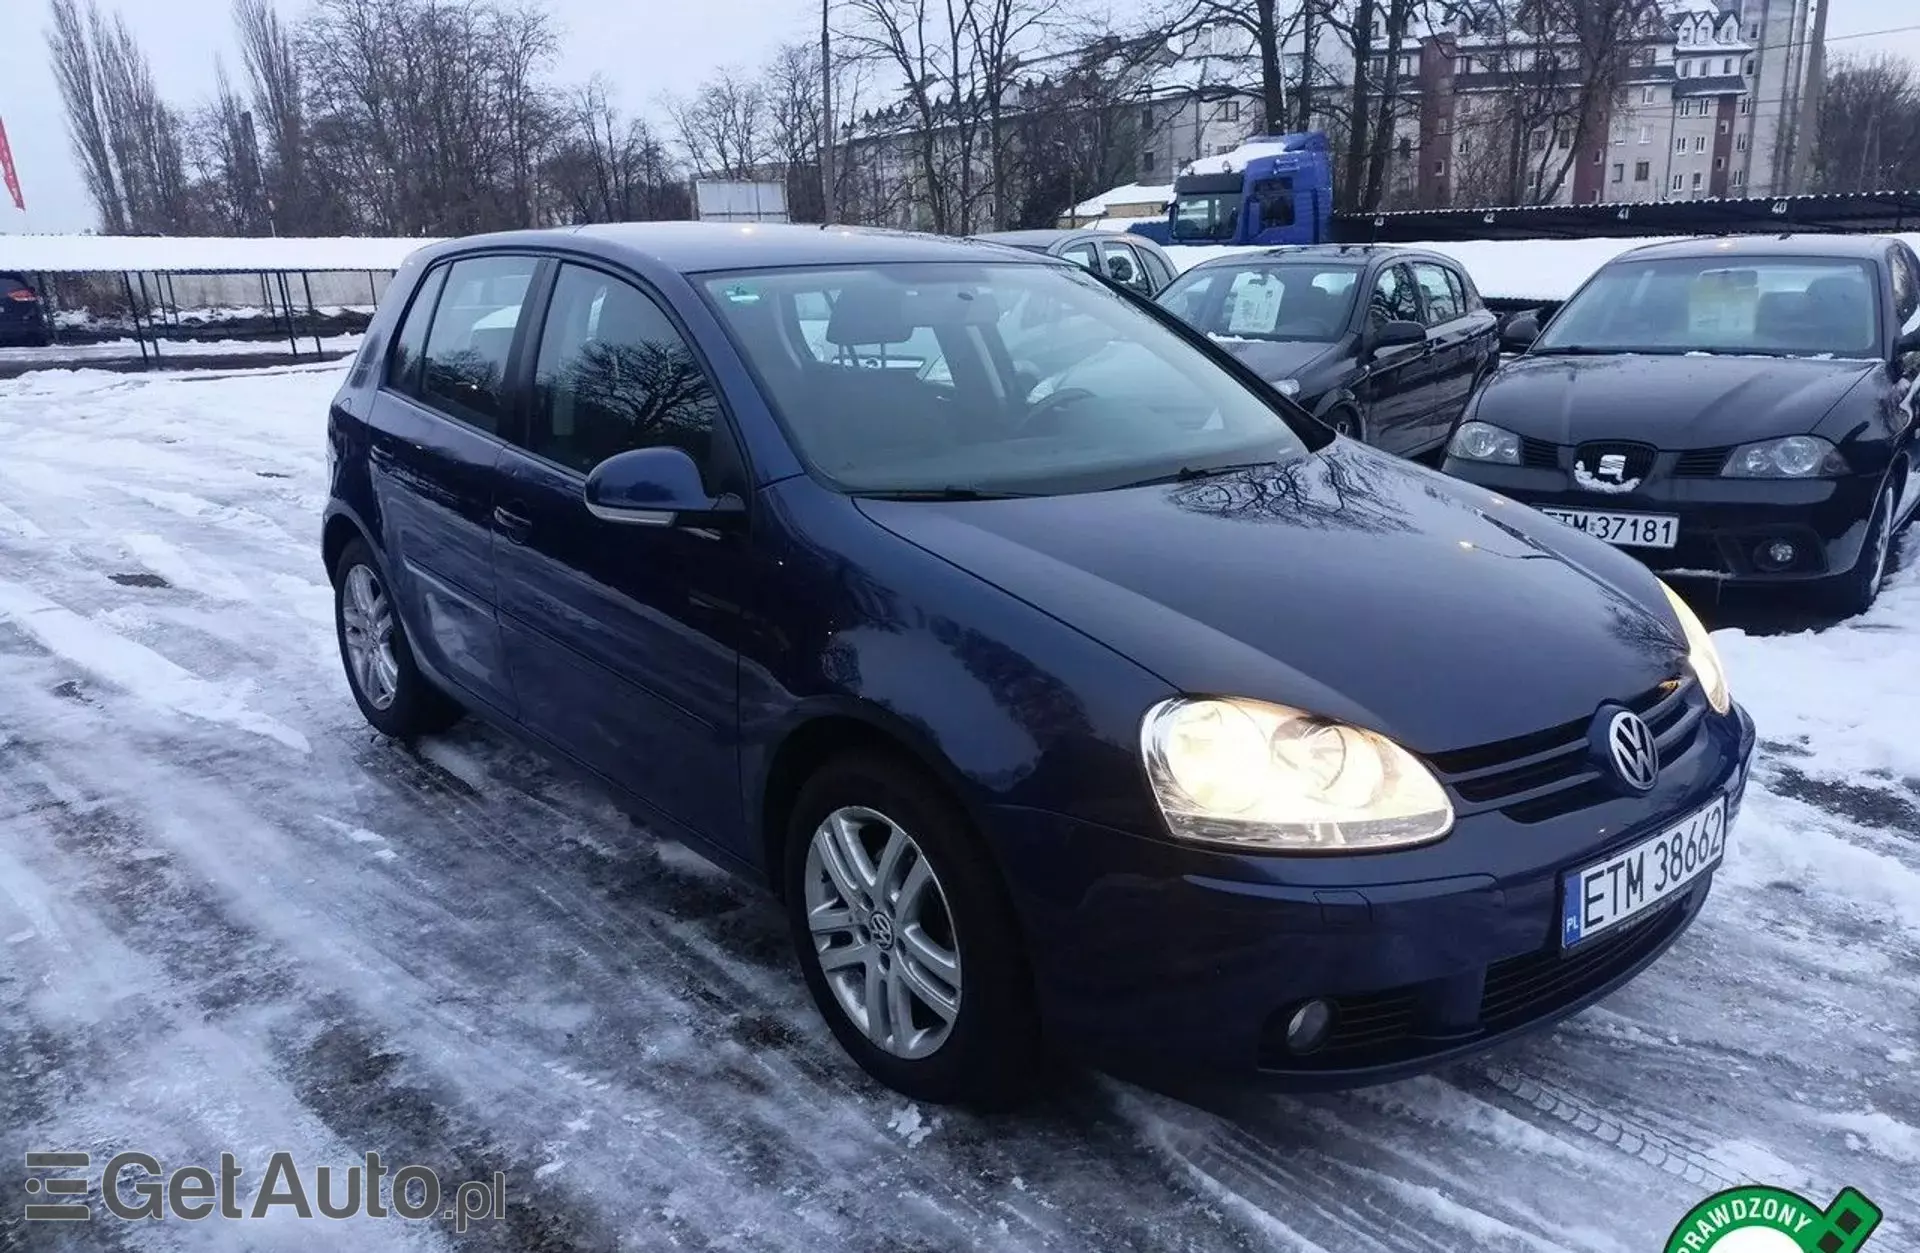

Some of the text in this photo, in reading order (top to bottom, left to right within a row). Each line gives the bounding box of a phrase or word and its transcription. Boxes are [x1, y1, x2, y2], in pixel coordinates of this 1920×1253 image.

[1771, 201, 1788, 214] 40
[1595, 516, 1671, 544] 37181
[1583, 851, 1644, 929] ETM
[1654, 806, 1722, 892] 38662
[1566, 915, 1579, 933] PL
